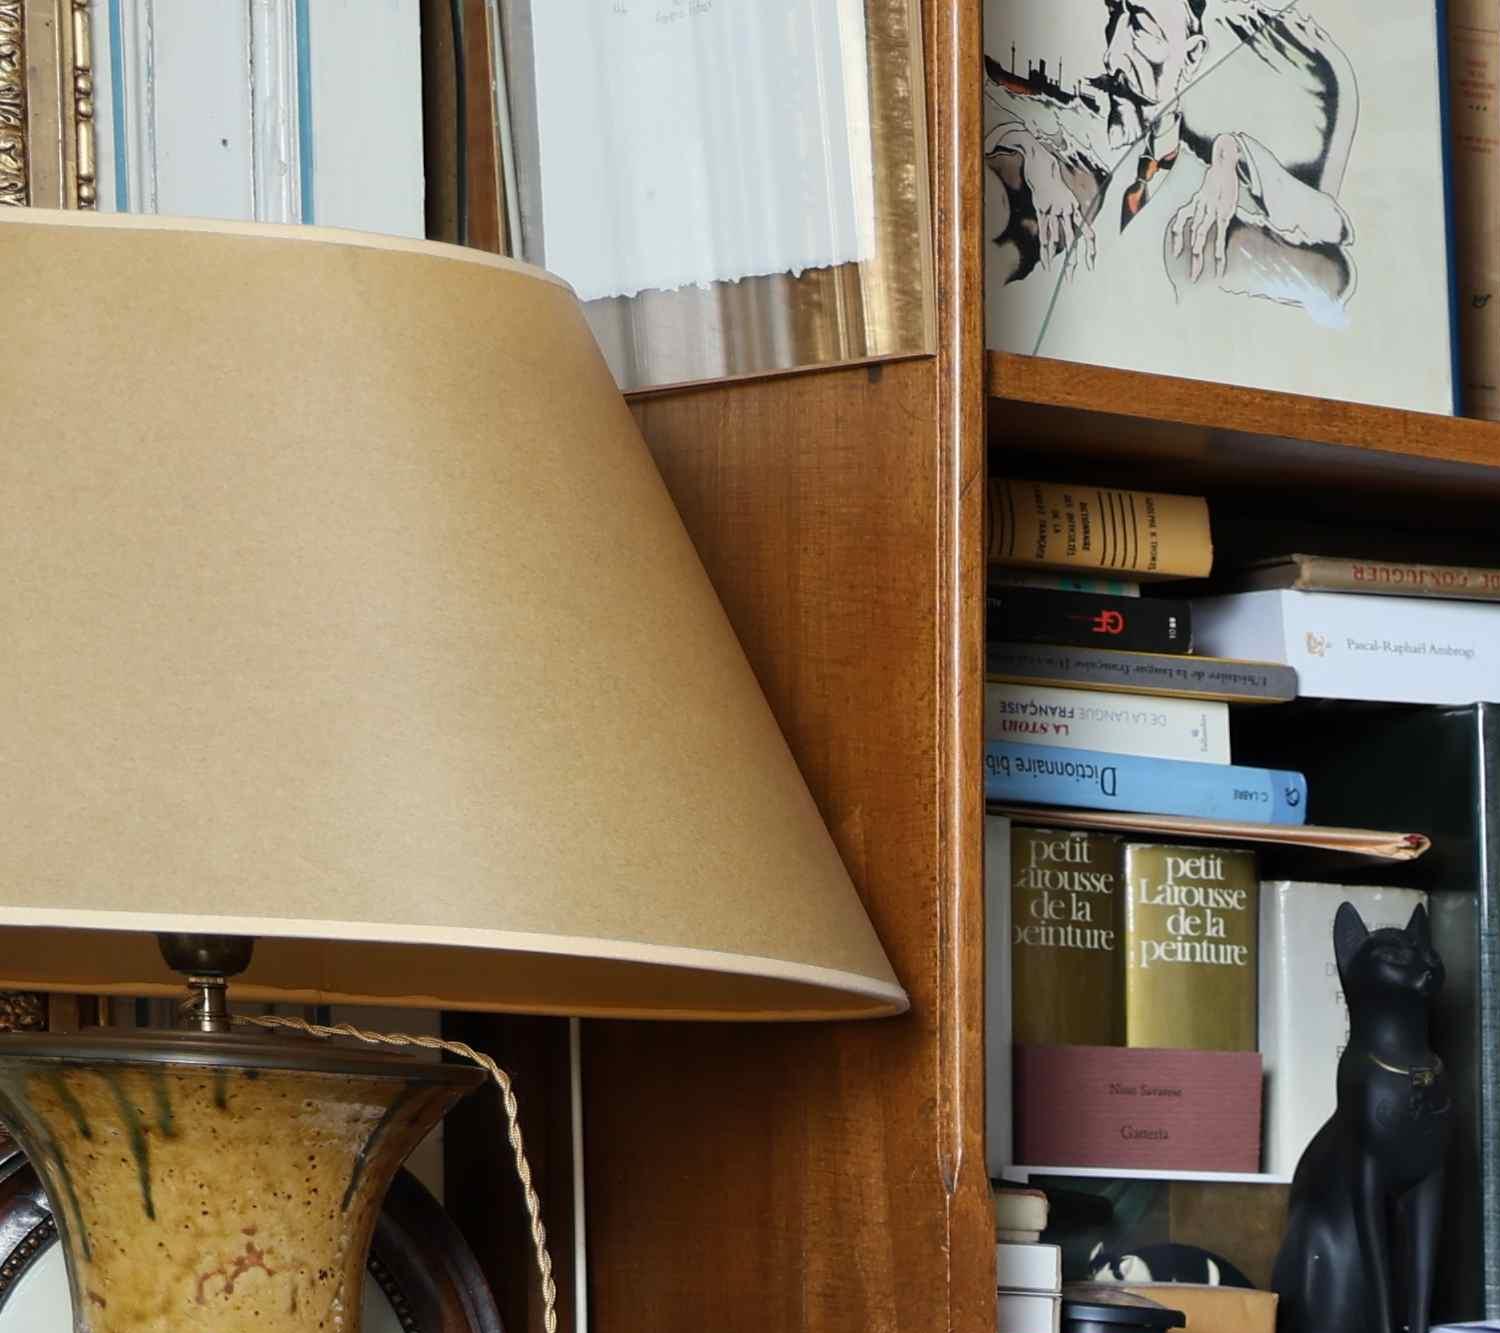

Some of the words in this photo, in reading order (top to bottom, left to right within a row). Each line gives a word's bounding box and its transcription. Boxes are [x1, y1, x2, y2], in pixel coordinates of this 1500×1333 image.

[1480, 574, 1500, 590] DE
[1092, 610, 1125, 635] GF
[1000, 700, 1075, 720] FRANÇAISE
[1054, 722, 1070, 736] LA
[1017, 758, 1118, 798] Dictionnaire
[1030, 833, 1092, 865] petit
[1166, 854, 1225, 885] petit
[1030, 893, 1065, 922] de
[1070, 893, 1093, 922] la
[1138, 878, 1248, 912] Larousse
[1166, 909, 1201, 937] de
[1204, 909, 1228, 938] la
[1139, 936, 1248, 968] peinture
